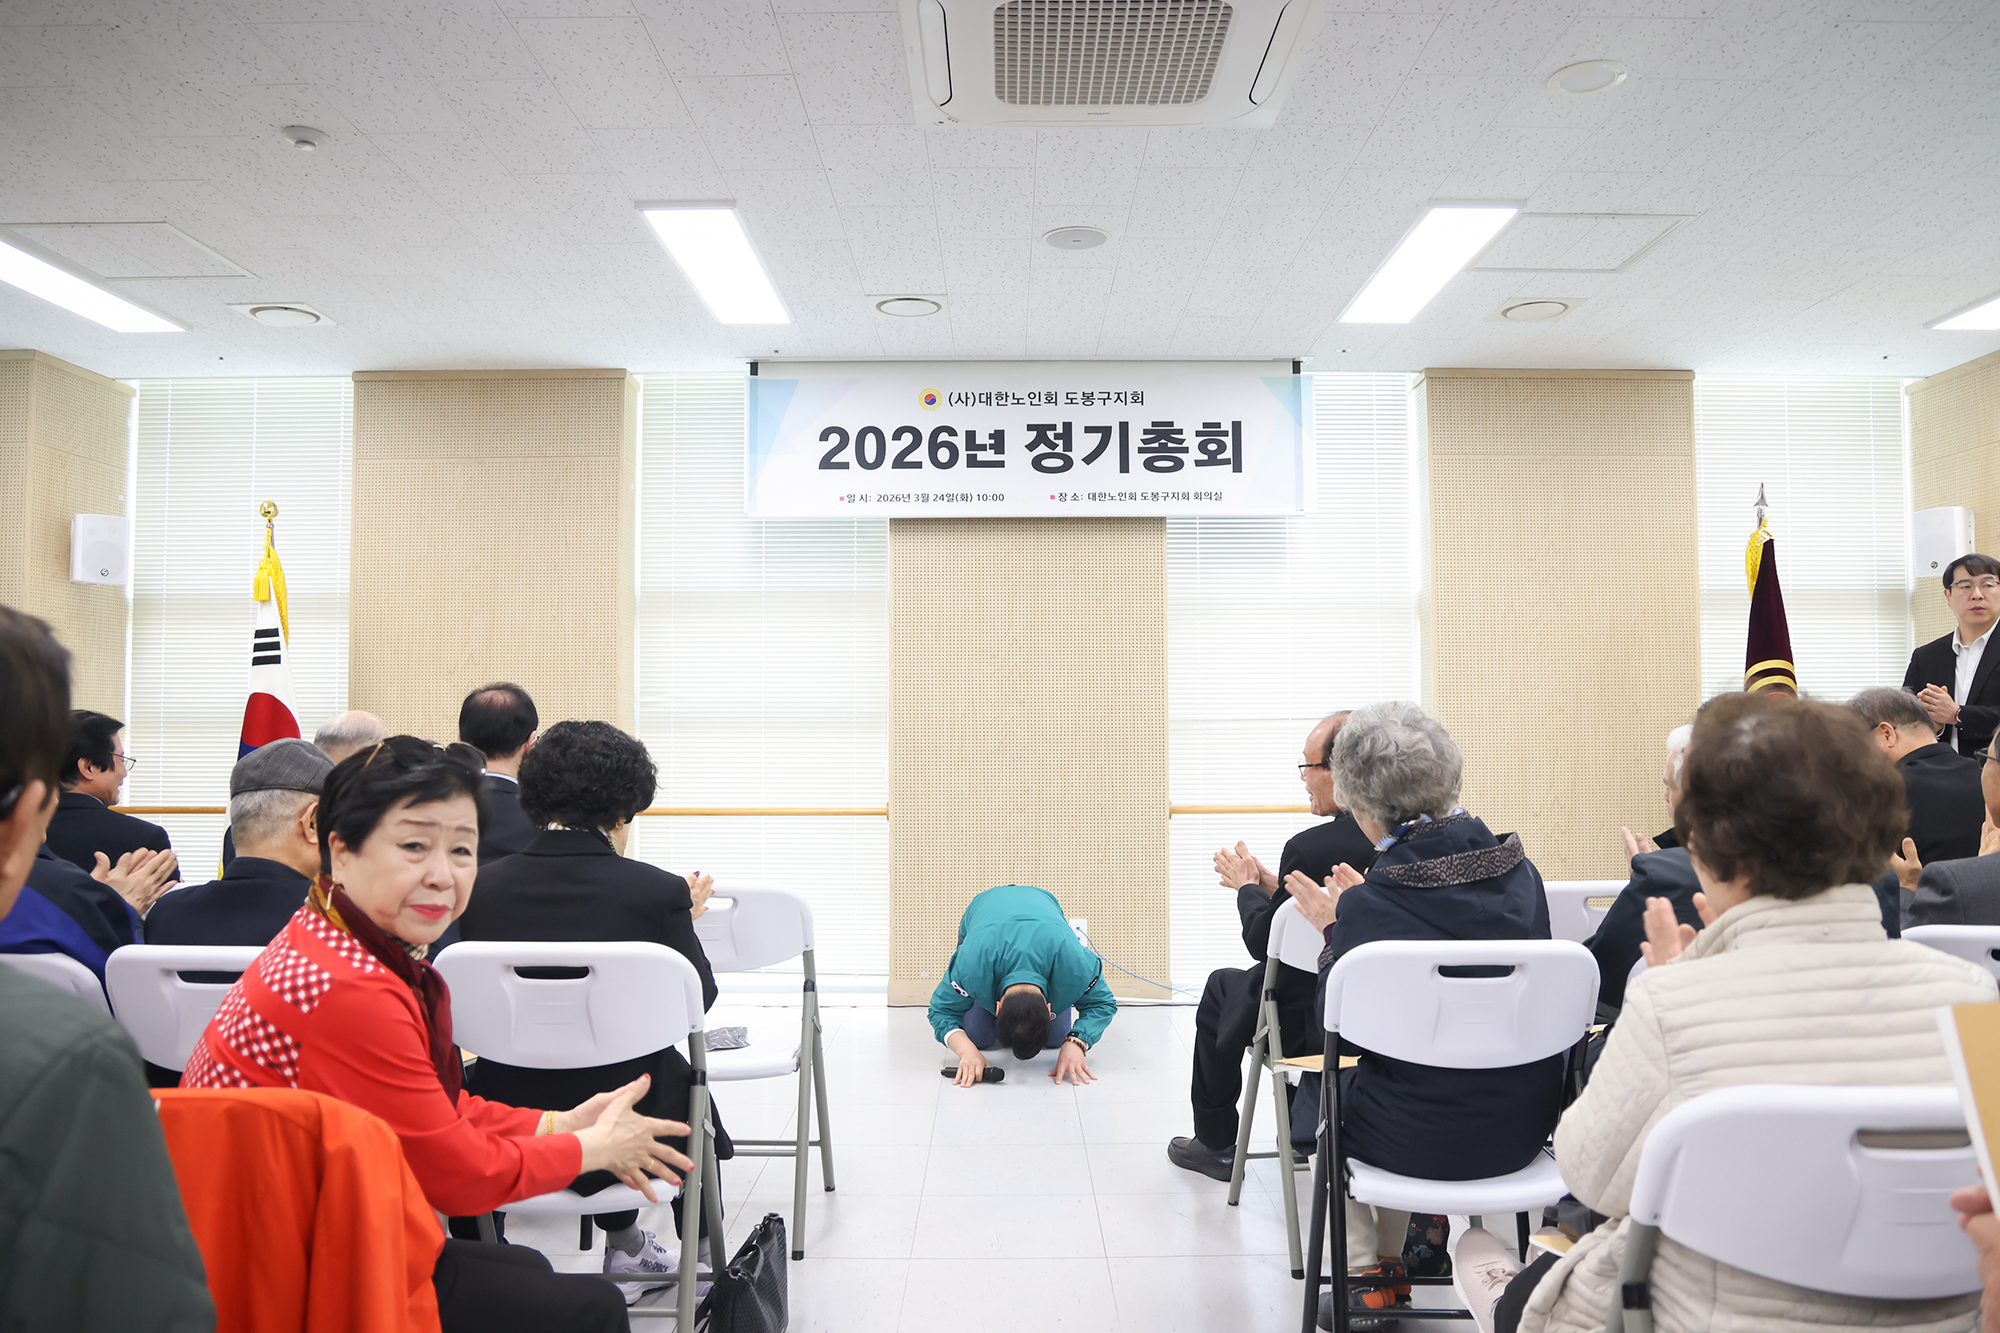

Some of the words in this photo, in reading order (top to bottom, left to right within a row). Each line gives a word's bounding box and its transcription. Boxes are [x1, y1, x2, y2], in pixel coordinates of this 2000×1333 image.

[948, 391, 1058, 407] (사)대한노인회
[1064, 391, 1145, 407] 도봉구지회
[818, 425, 1006, 471] 2026년
[1024, 420, 1243, 474] 정기총회
[846, 493, 856, 503] 일
[858, 493, 872, 503] 시:
[876, 493, 911, 503] 2026년
[914, 493, 930, 503] 3월
[932, 492, 974, 503] 24일(화)
[976, 493, 1005, 502] 10:00
[1058, 492, 1068, 502] 장
[1070, 493, 1084, 502] 소:
[1087, 491, 1137, 502] 대한노인회
[1140, 491, 1190, 502] 도봉구지회
[1193, 491, 1223, 502] 회의실
